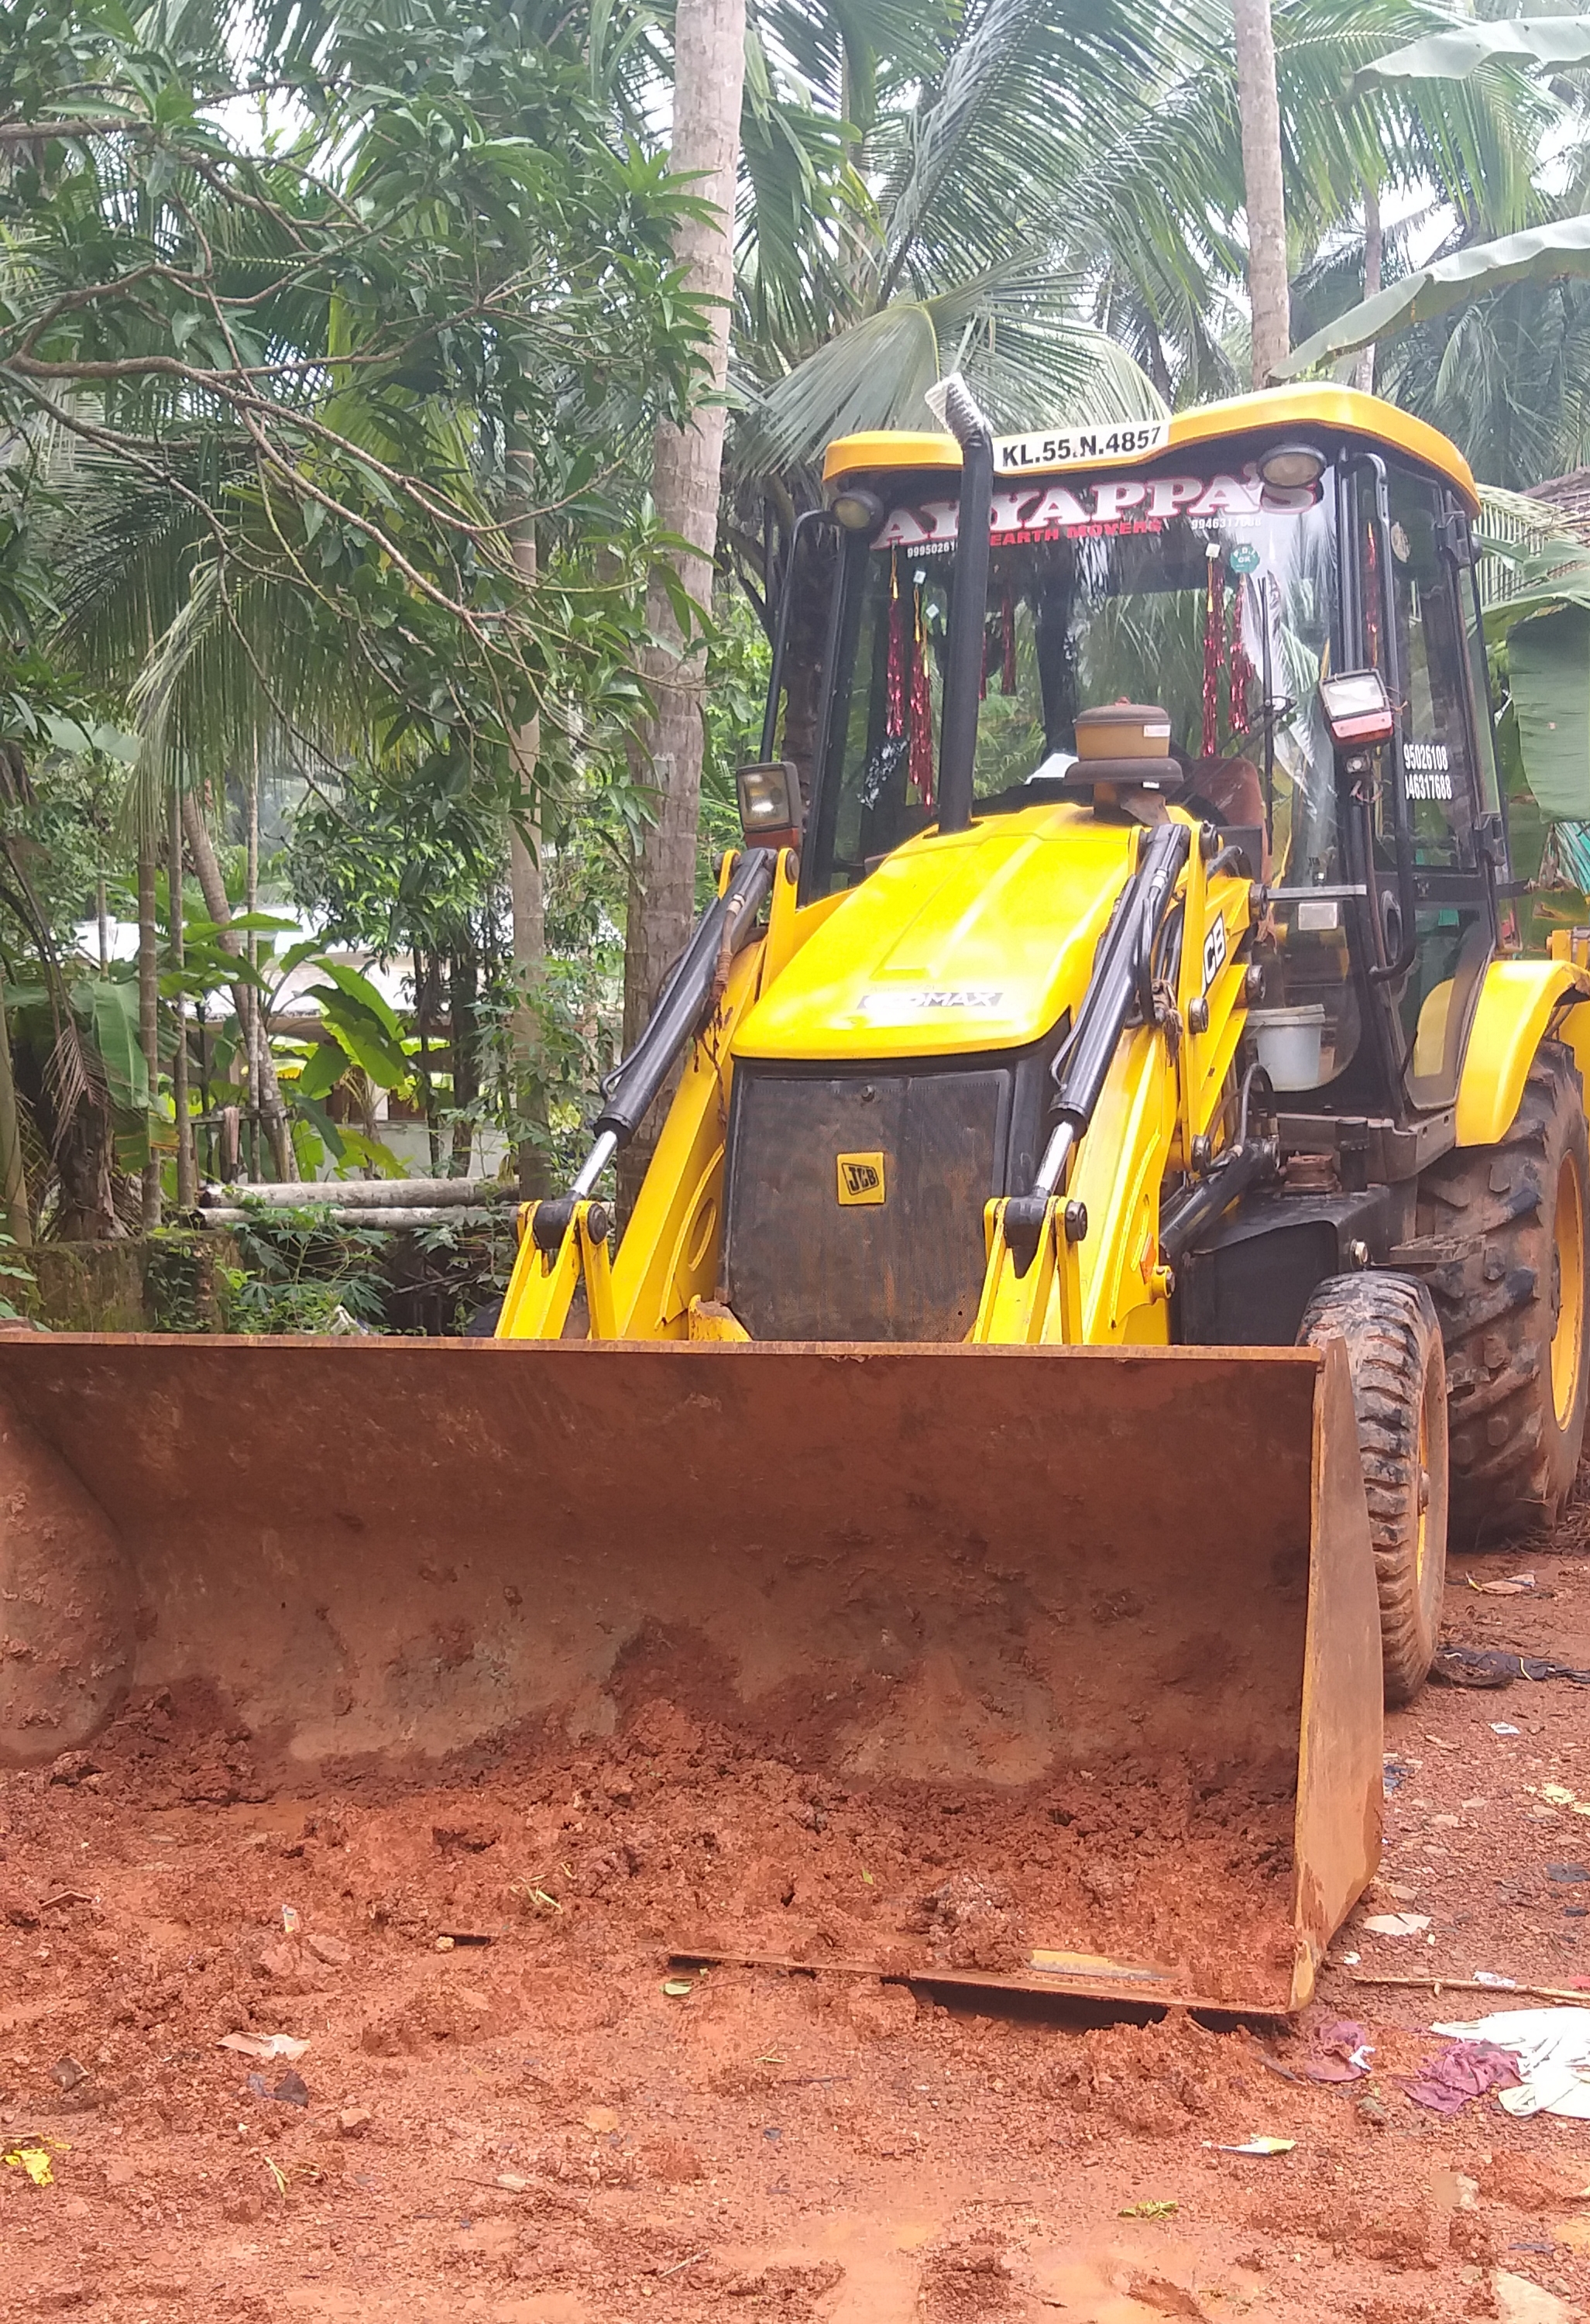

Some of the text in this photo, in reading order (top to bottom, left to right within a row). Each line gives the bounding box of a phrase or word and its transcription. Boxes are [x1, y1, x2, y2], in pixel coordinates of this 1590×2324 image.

[1002, 427, 1162, 467] KL.55.N.4857
[990, 521, 1163, 547] EARTH MOVERS
[907, 539, 958, 558] 99950261
[848, 1166, 877, 1191] JCB
